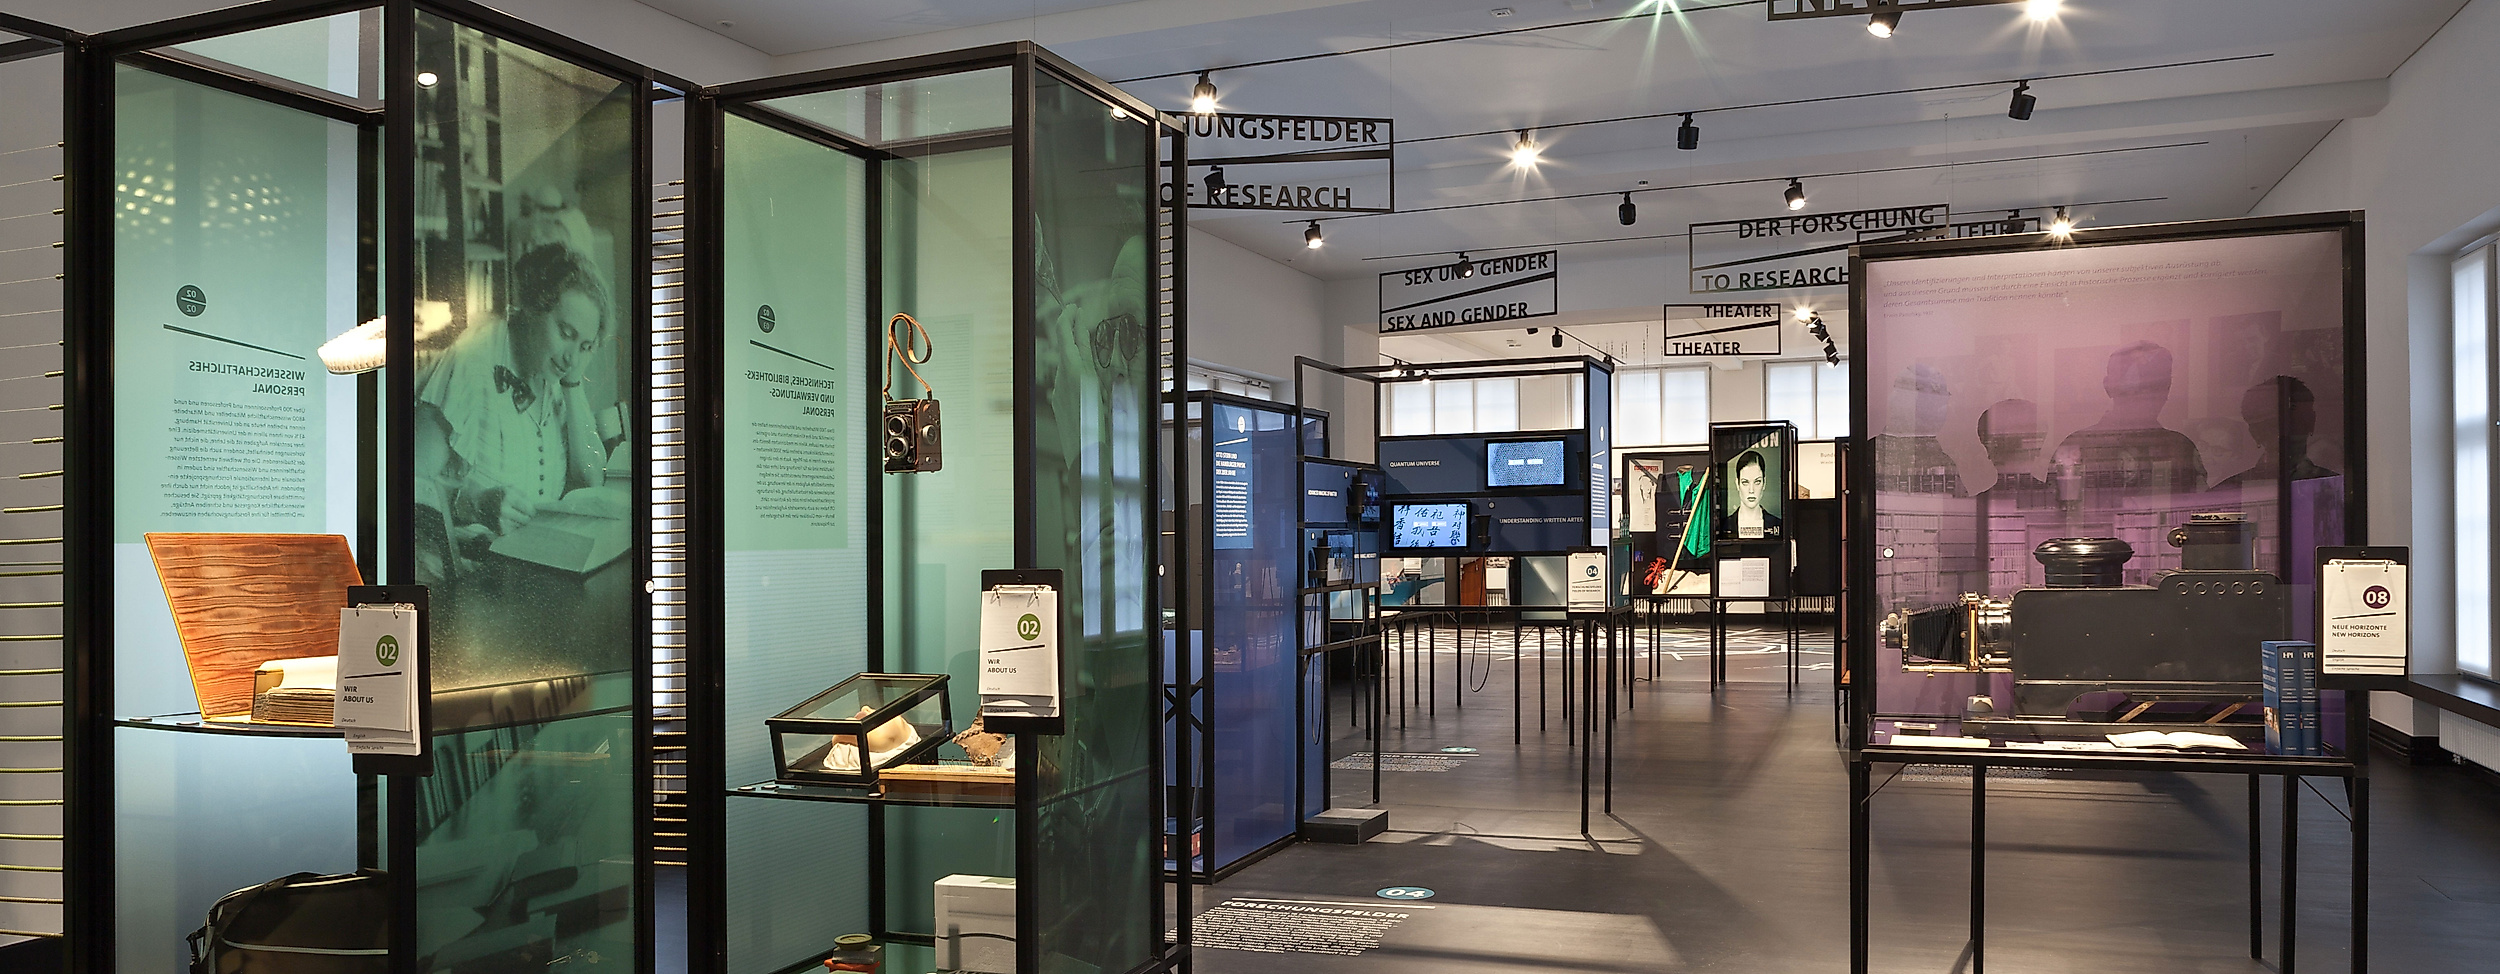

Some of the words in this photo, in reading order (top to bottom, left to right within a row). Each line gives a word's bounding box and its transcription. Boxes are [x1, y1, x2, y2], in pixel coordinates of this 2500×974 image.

[1739, 219, 1782, 239] DER
[1790, 207, 1934, 235] FORSCHUNG
[1404, 269, 1434, 286] SEX
[1439, 265, 1466, 282] UN
[1480, 254, 1548, 276] GENDER
[1702, 274, 1730, 292] TO
[1388, 314, 1416, 331] SEX
[1421, 310, 1456, 328] AND
[1462, 302, 1528, 323] GENDER
[1704, 305, 1772, 318] THEATER
[1672, 341, 1741, 354] THEATER
[2366, 591, 2388, 604] 08
[1020, 621, 1038, 635] 02
[379, 643, 396, 660] 02
[1385, 889, 1426, 898] 04
[1220, 901, 1410, 919] FORSCHUNGSFELDER
